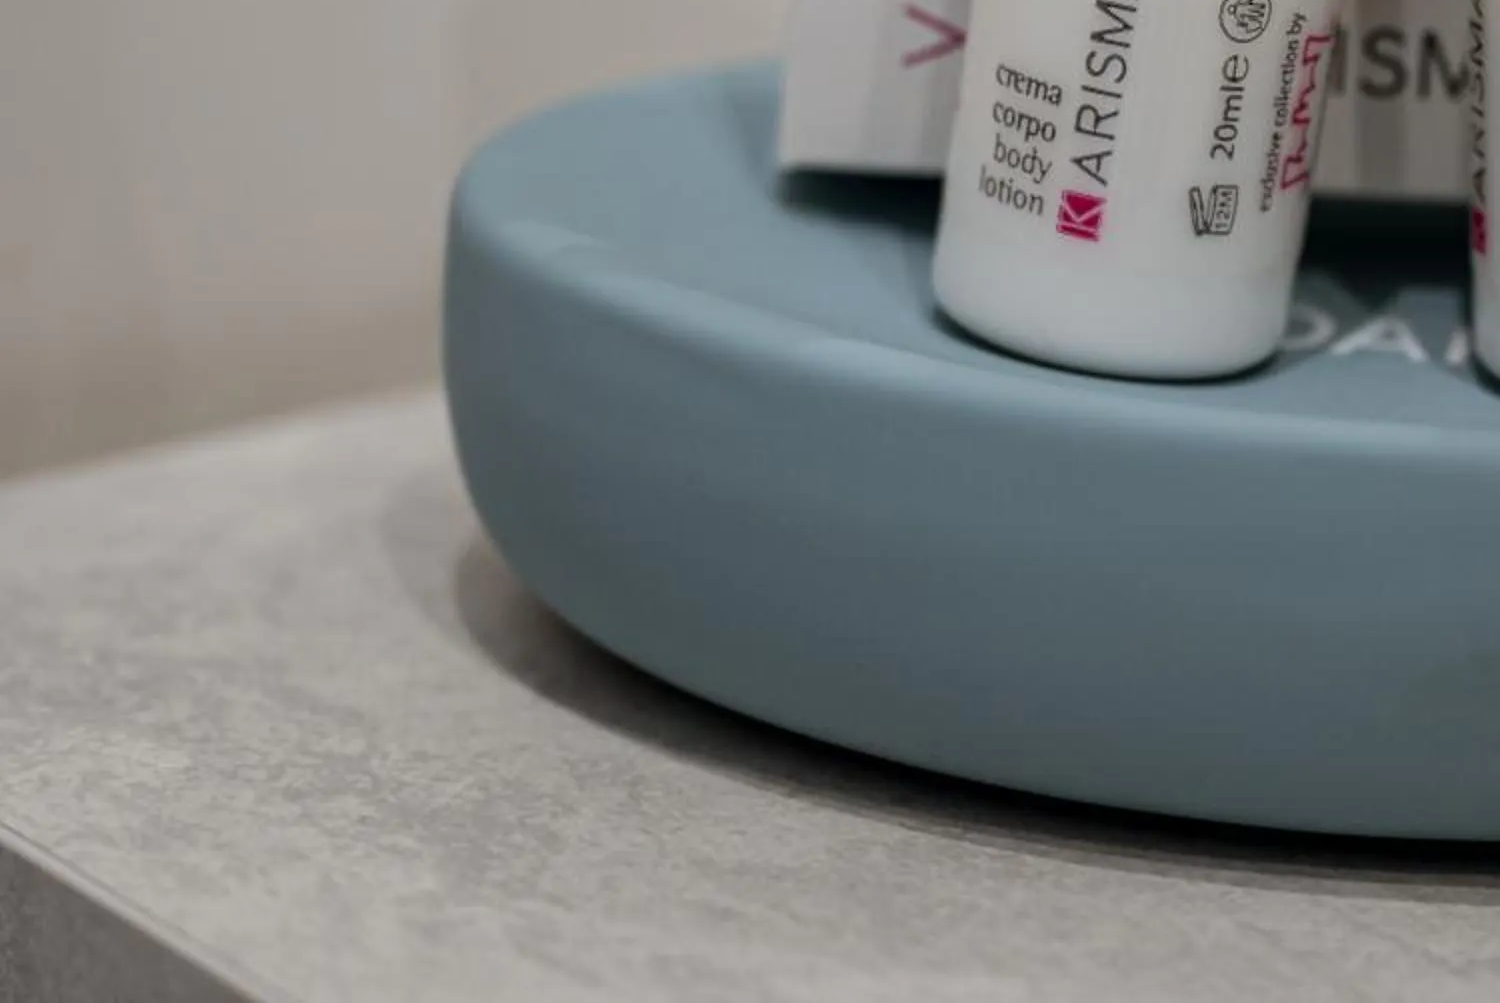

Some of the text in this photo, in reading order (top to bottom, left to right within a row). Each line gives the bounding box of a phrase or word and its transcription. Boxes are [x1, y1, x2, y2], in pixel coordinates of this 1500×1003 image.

[995, 63, 1063, 106] crema
[992, 101, 1057, 143] corpo
[1259, 12, 1308, 213] exclusive collection by
[993, 133, 1053, 184] body
[979, 164, 1045, 216] lotion
